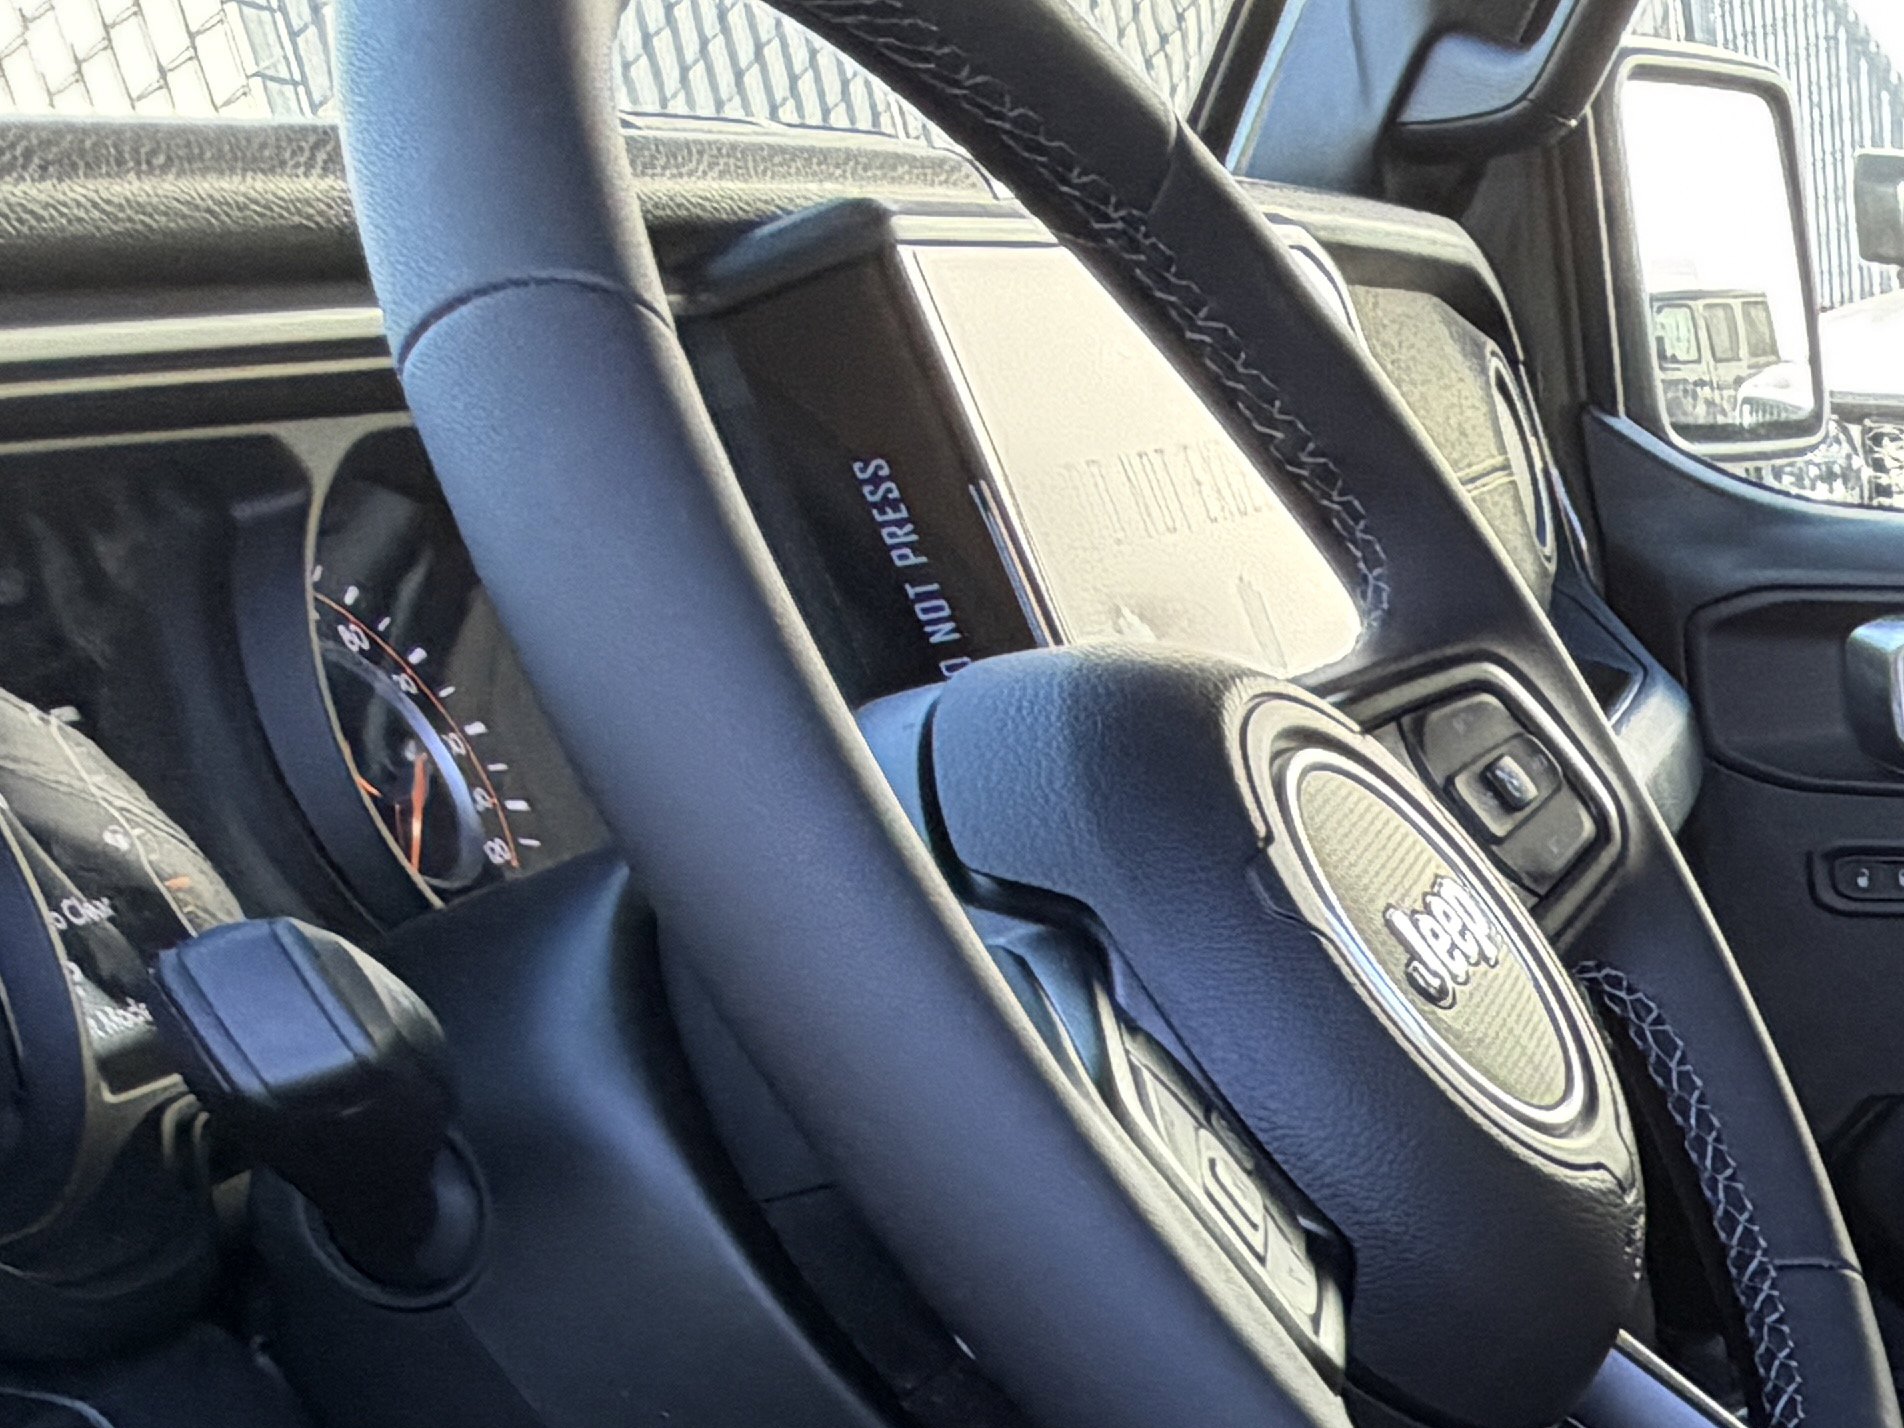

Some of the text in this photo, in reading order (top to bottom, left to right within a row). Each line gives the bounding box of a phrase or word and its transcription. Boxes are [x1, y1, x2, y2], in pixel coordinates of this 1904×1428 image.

[852, 458, 929, 567] PRESS
[904, 582, 962, 643] NOT
[1383, 872, 1509, 1009] Jeep
